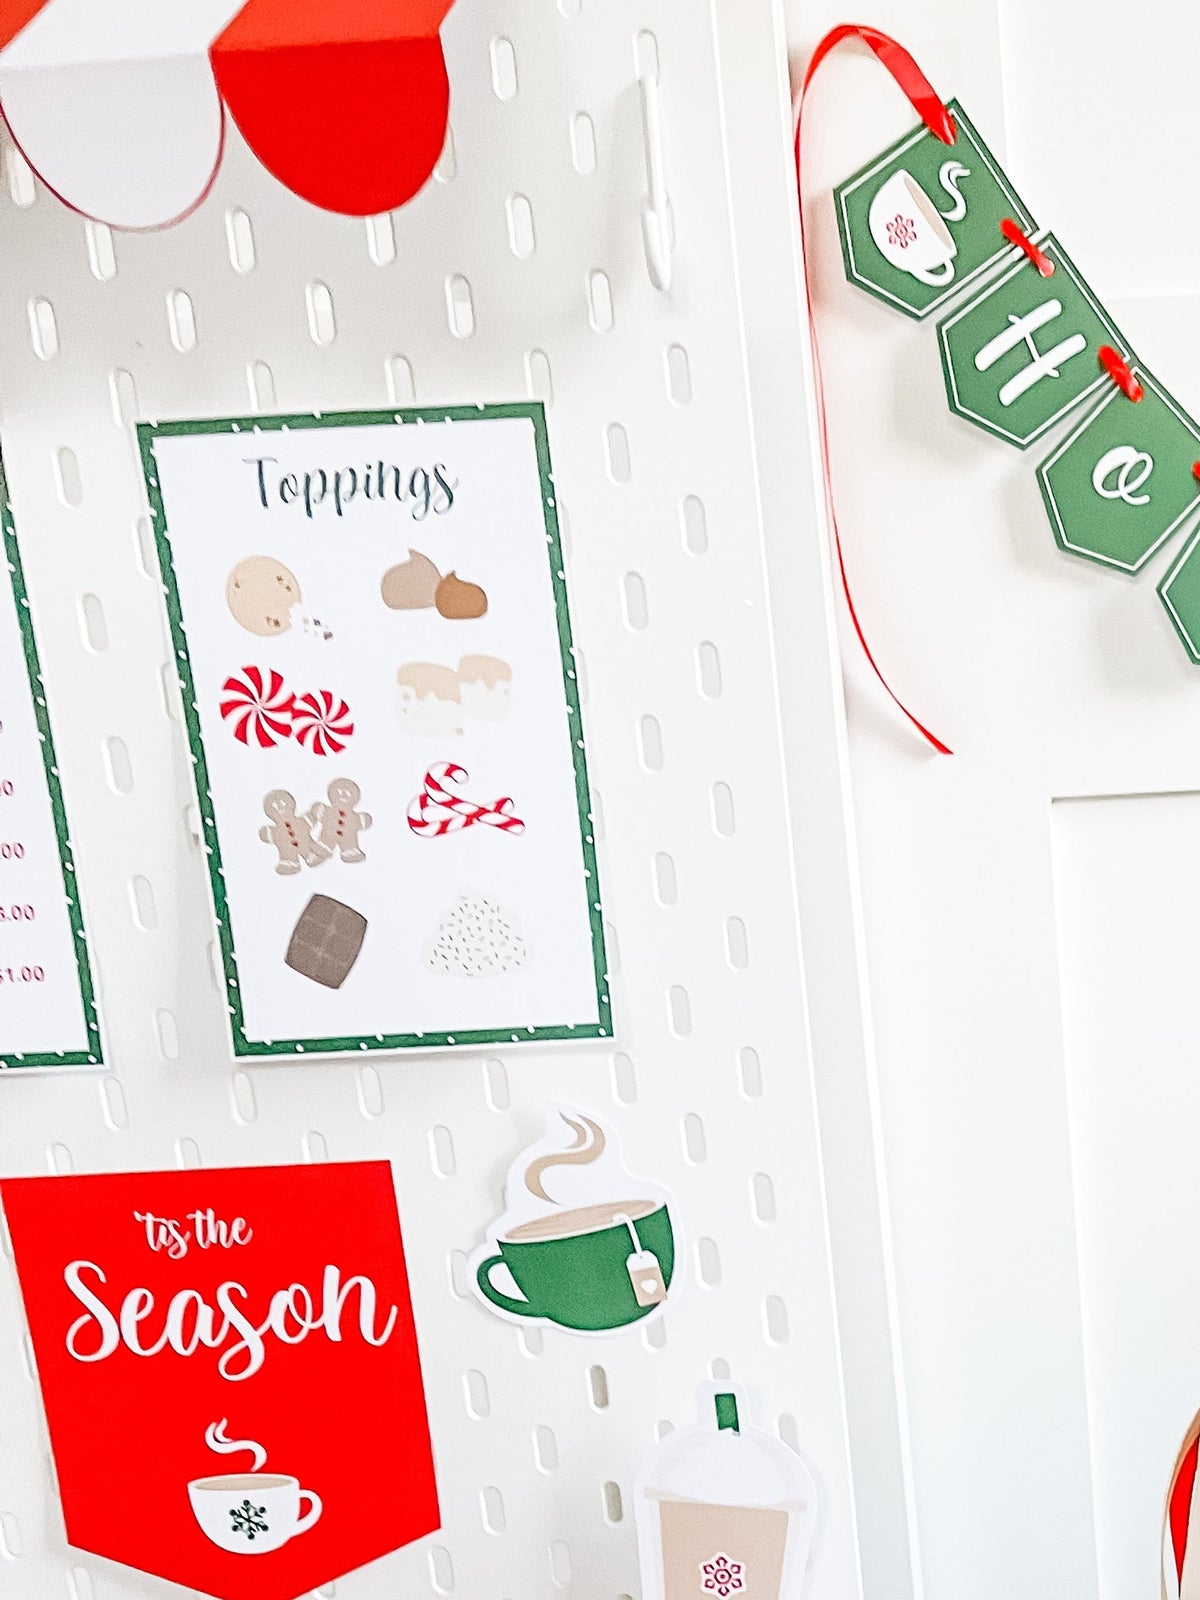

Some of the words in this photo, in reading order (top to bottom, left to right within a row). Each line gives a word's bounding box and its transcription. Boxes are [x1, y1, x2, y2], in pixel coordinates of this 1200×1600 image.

[242, 456, 458, 521] Toppings
[186, 1207, 253, 1250] the
[64, 1260, 398, 1382] Season
